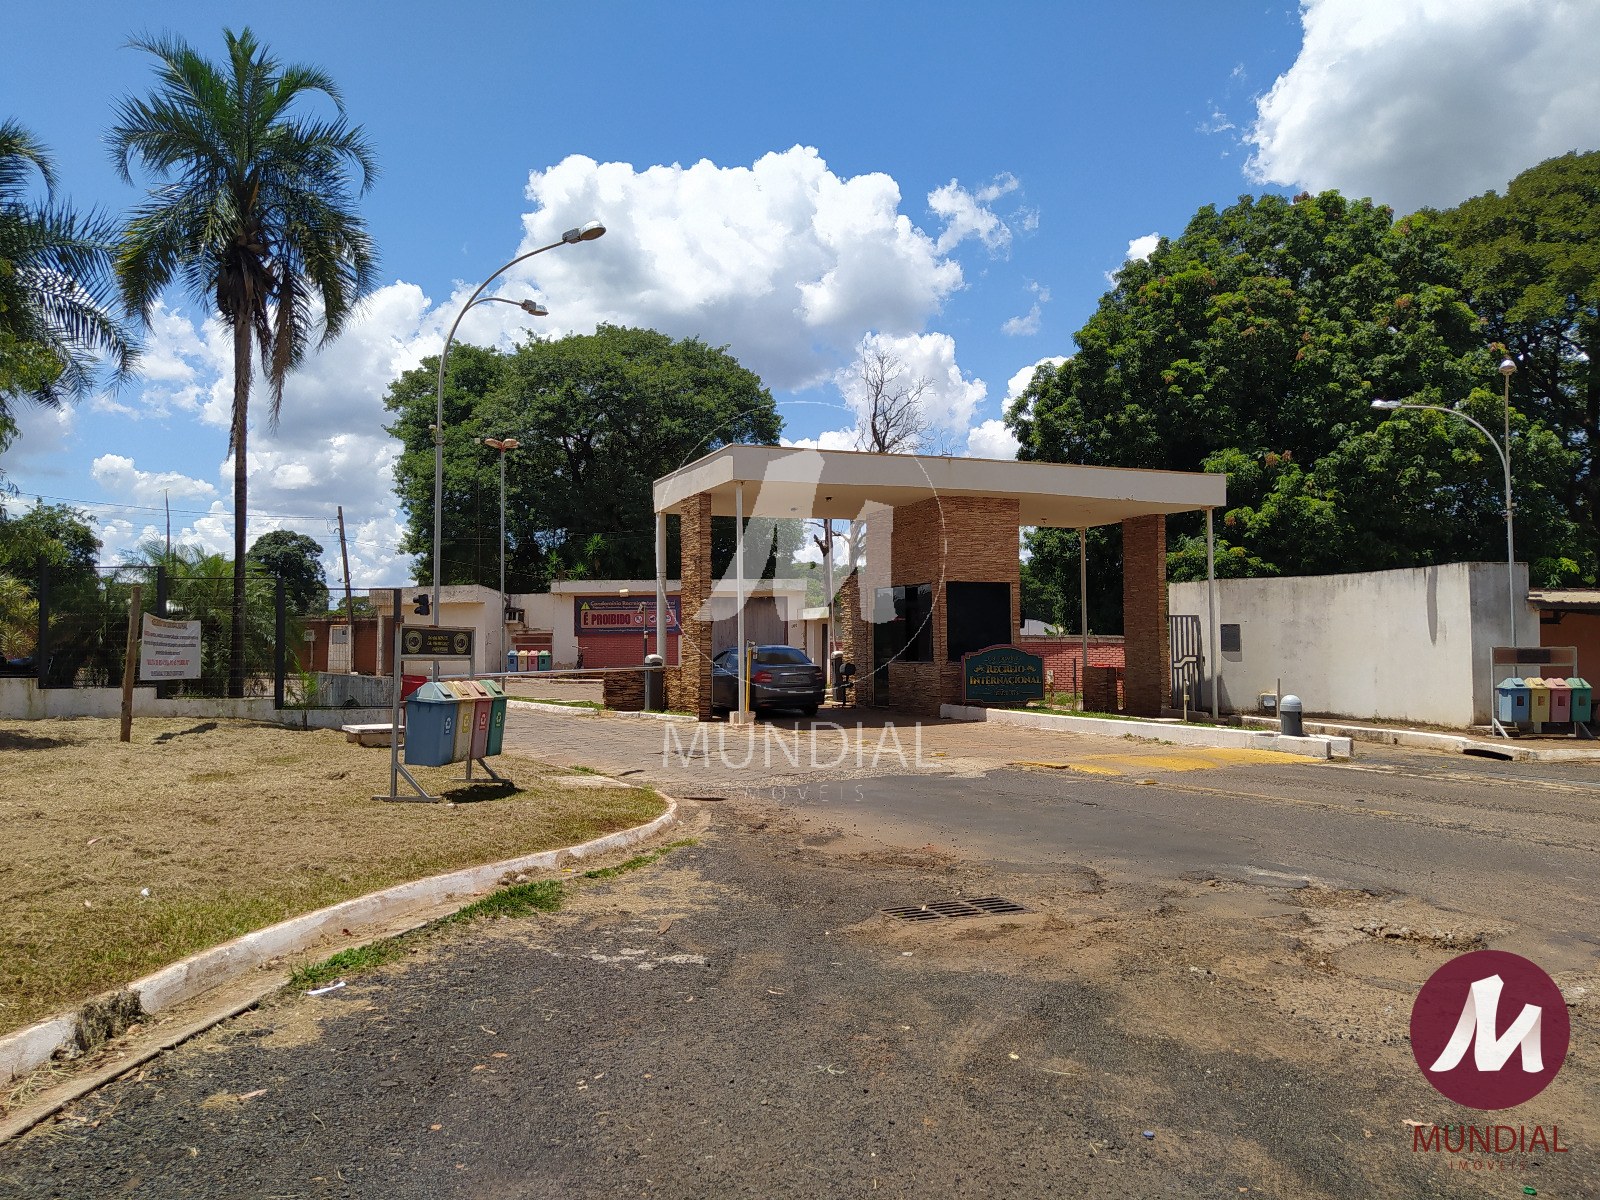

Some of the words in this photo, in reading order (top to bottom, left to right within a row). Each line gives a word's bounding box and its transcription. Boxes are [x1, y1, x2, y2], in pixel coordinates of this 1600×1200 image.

[583, 612, 589, 625] É
[591, 613, 631, 625] PROIBIDO
[986, 664, 1026, 674] RECREIO
[970, 675, 1042, 685] INTERNACIONAL
